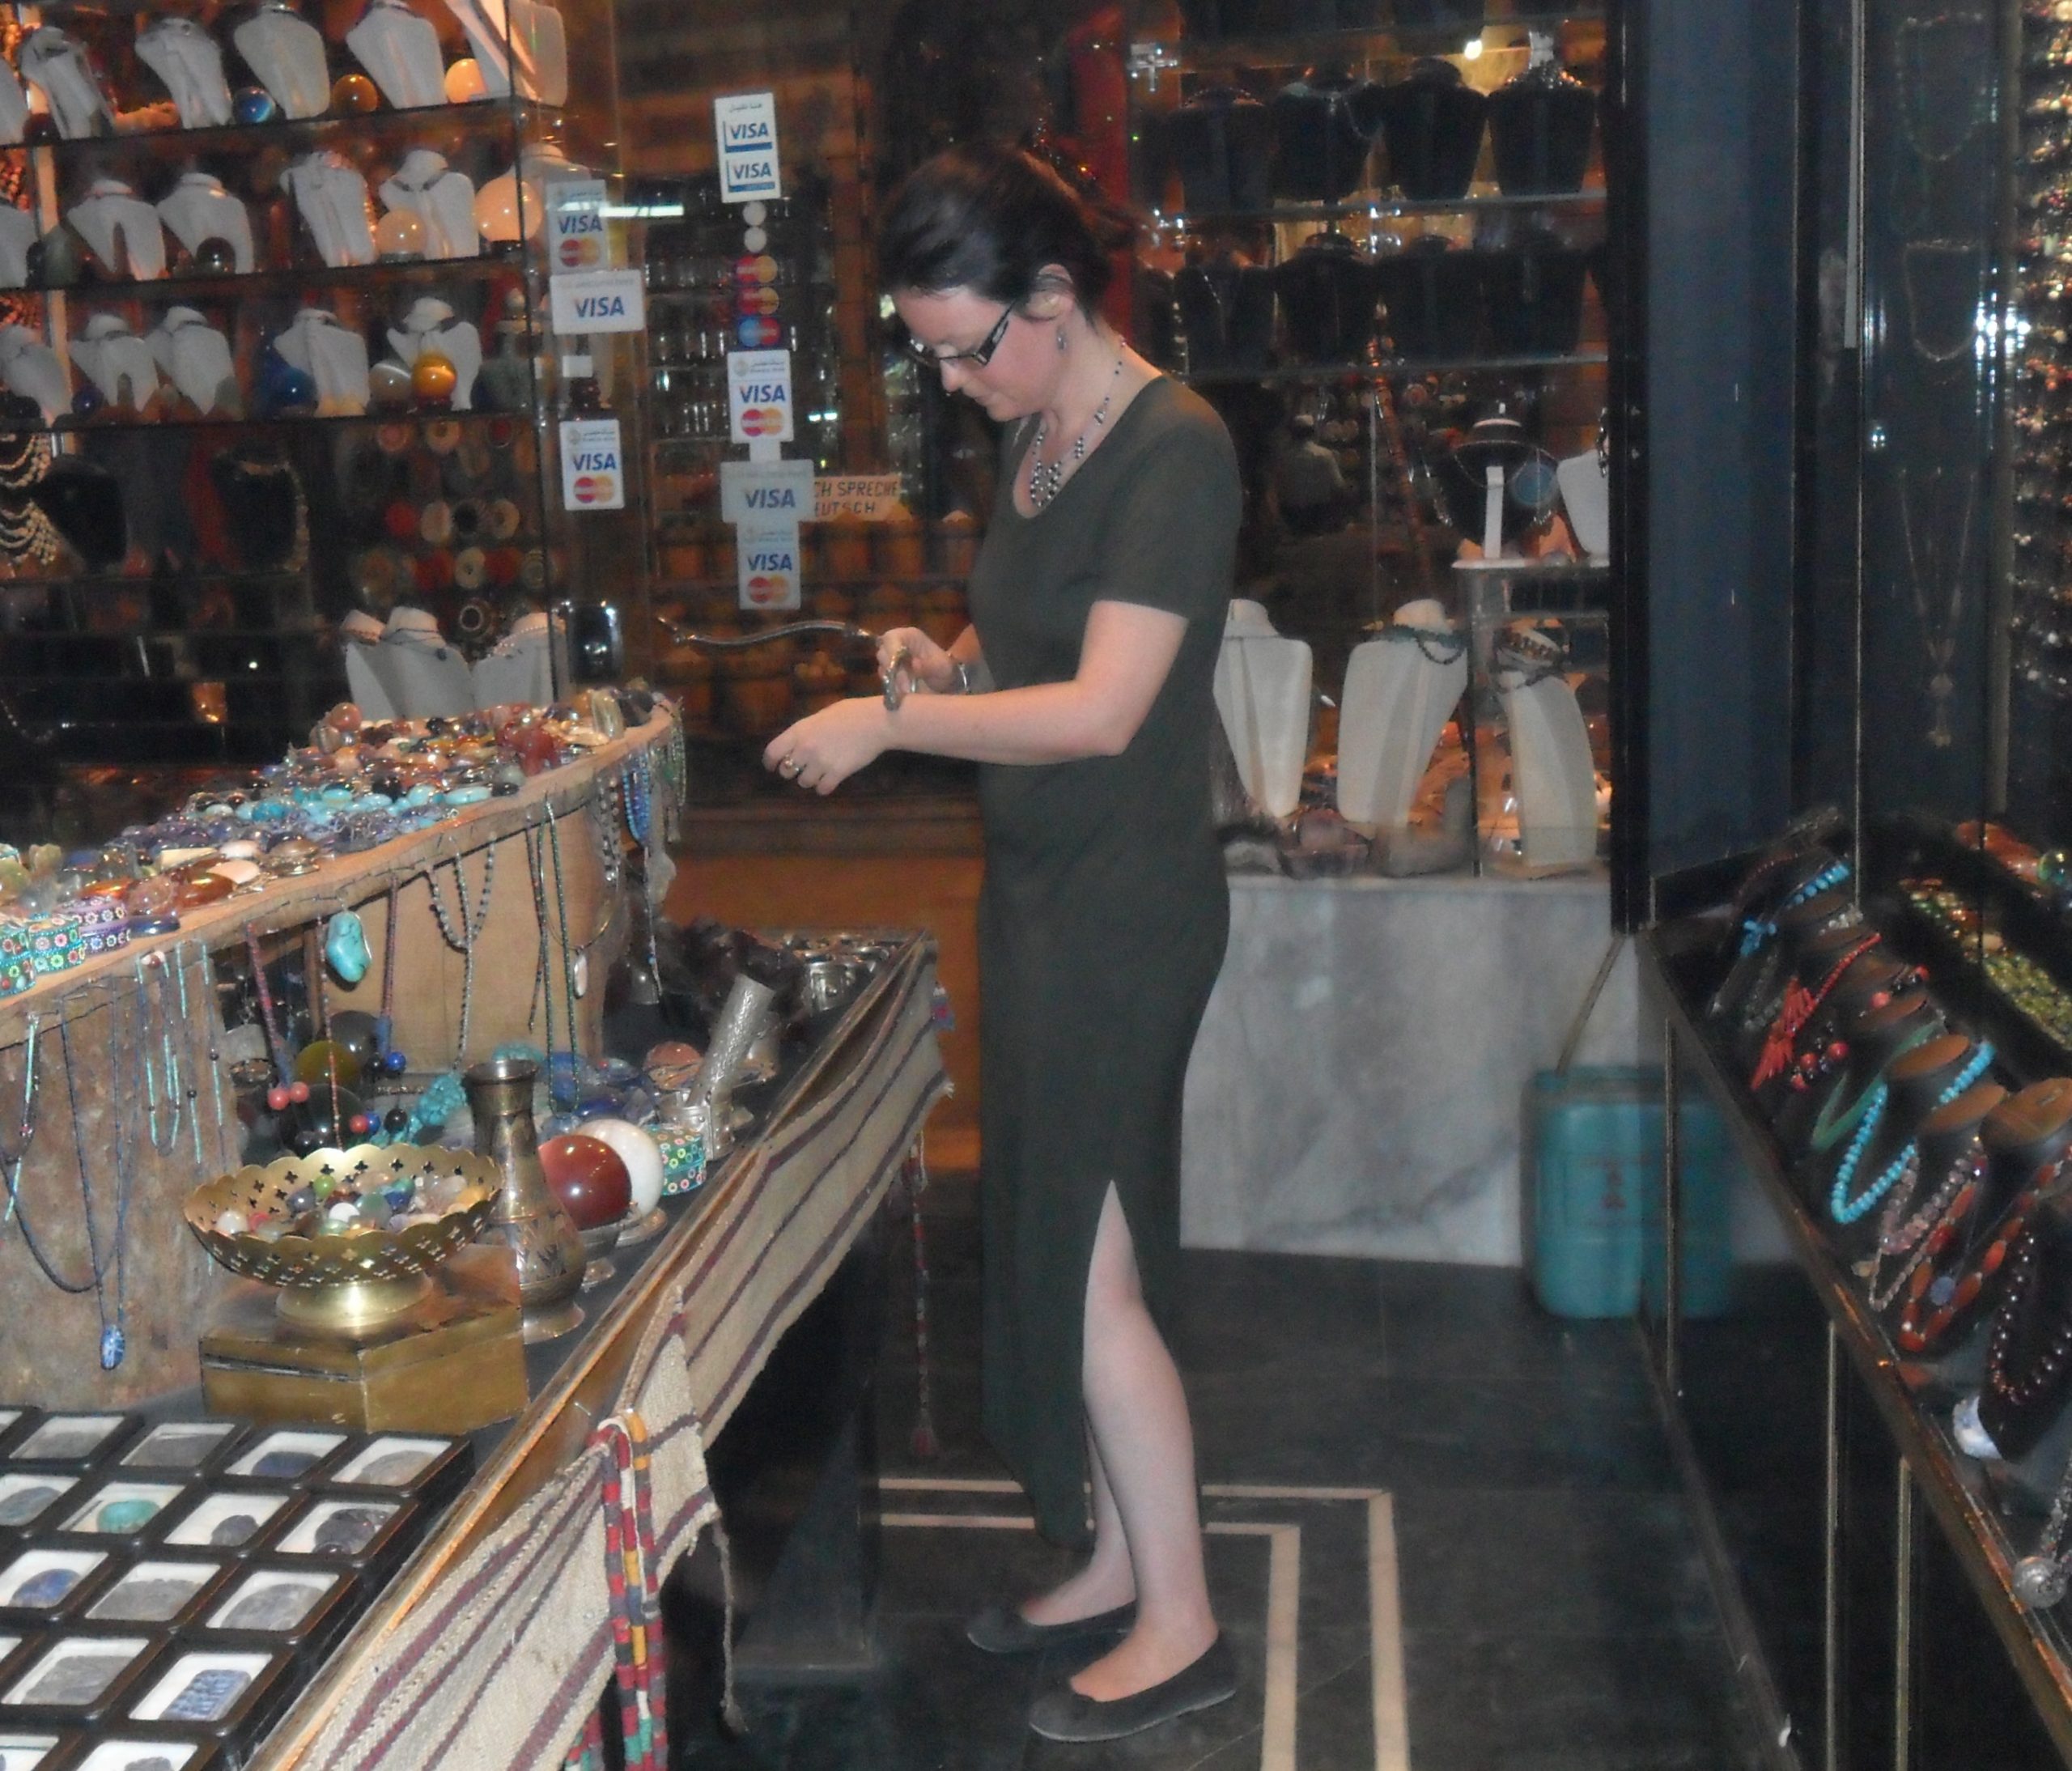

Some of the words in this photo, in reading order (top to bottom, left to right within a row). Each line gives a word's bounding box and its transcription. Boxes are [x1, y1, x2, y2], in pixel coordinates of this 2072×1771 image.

[730, 122, 769, 140] VISA
[732, 162, 772, 180] VISA
[558, 214, 603, 234] VISA
[573, 295, 625, 318] VISA
[739, 384, 786, 403] VISA
[571, 452, 617, 471] VISA
[743, 487, 796, 509] VISA
[746, 553, 792, 571] VISA
